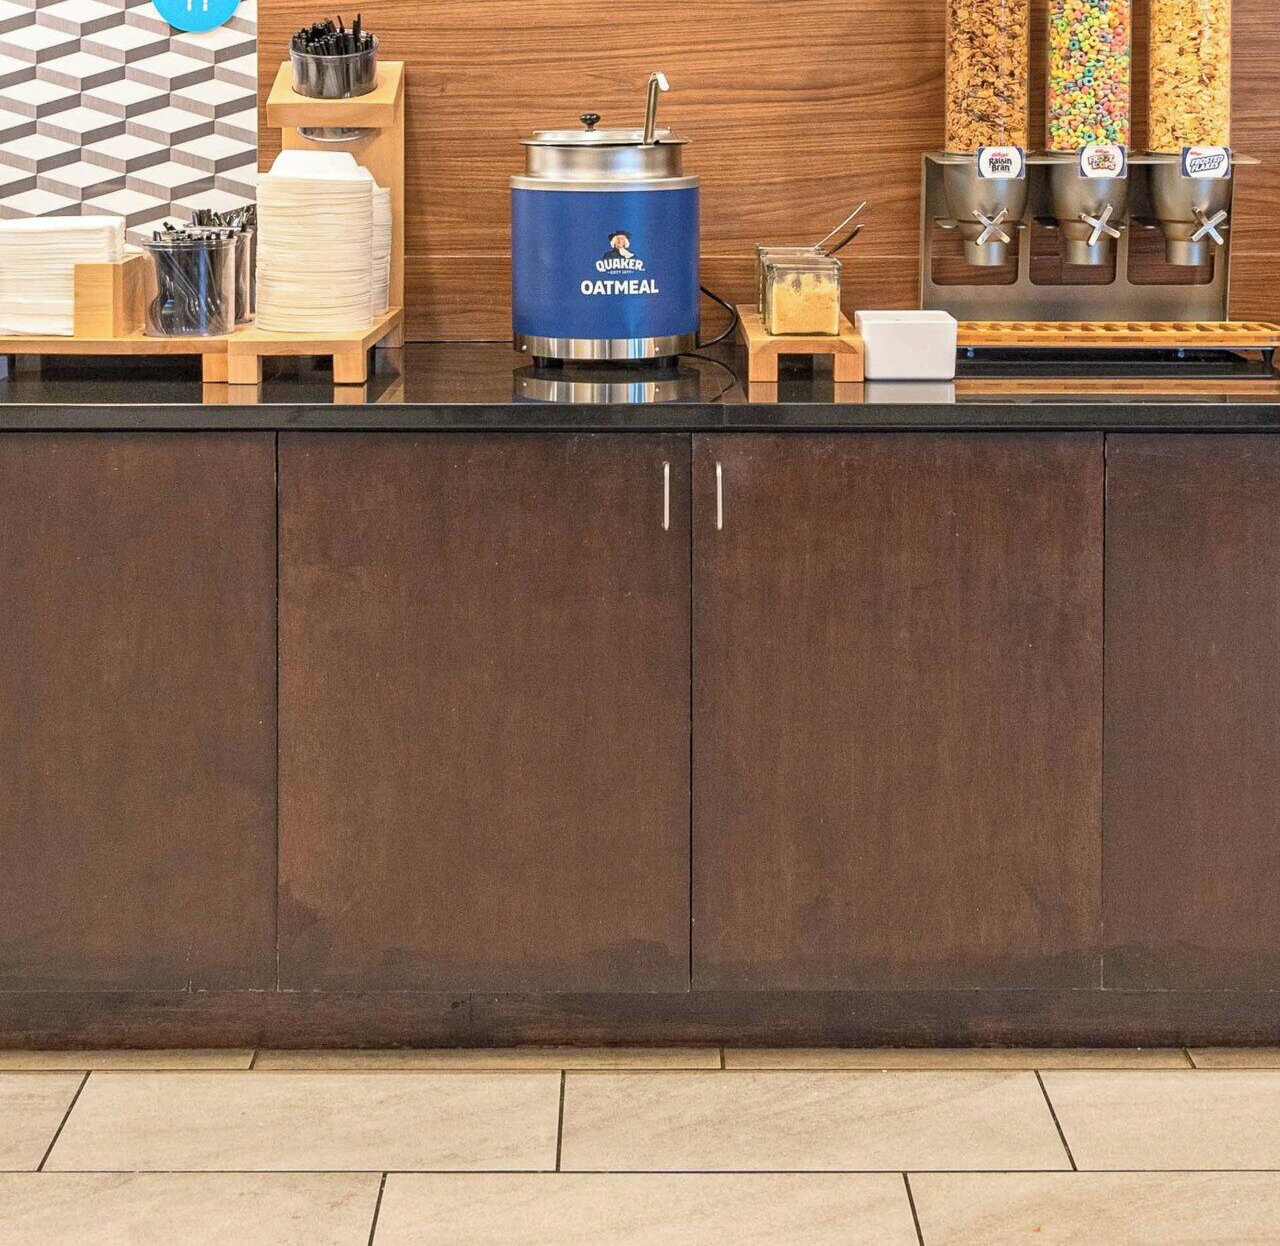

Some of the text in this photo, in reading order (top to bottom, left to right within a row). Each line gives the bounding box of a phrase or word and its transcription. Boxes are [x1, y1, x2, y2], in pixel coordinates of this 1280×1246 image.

[988, 157, 1012, 166] Raisin
[991, 163, 1011, 173] Bran
[595, 258, 644, 272] QUAKER
[581, 279, 659, 295] OATMEAL
